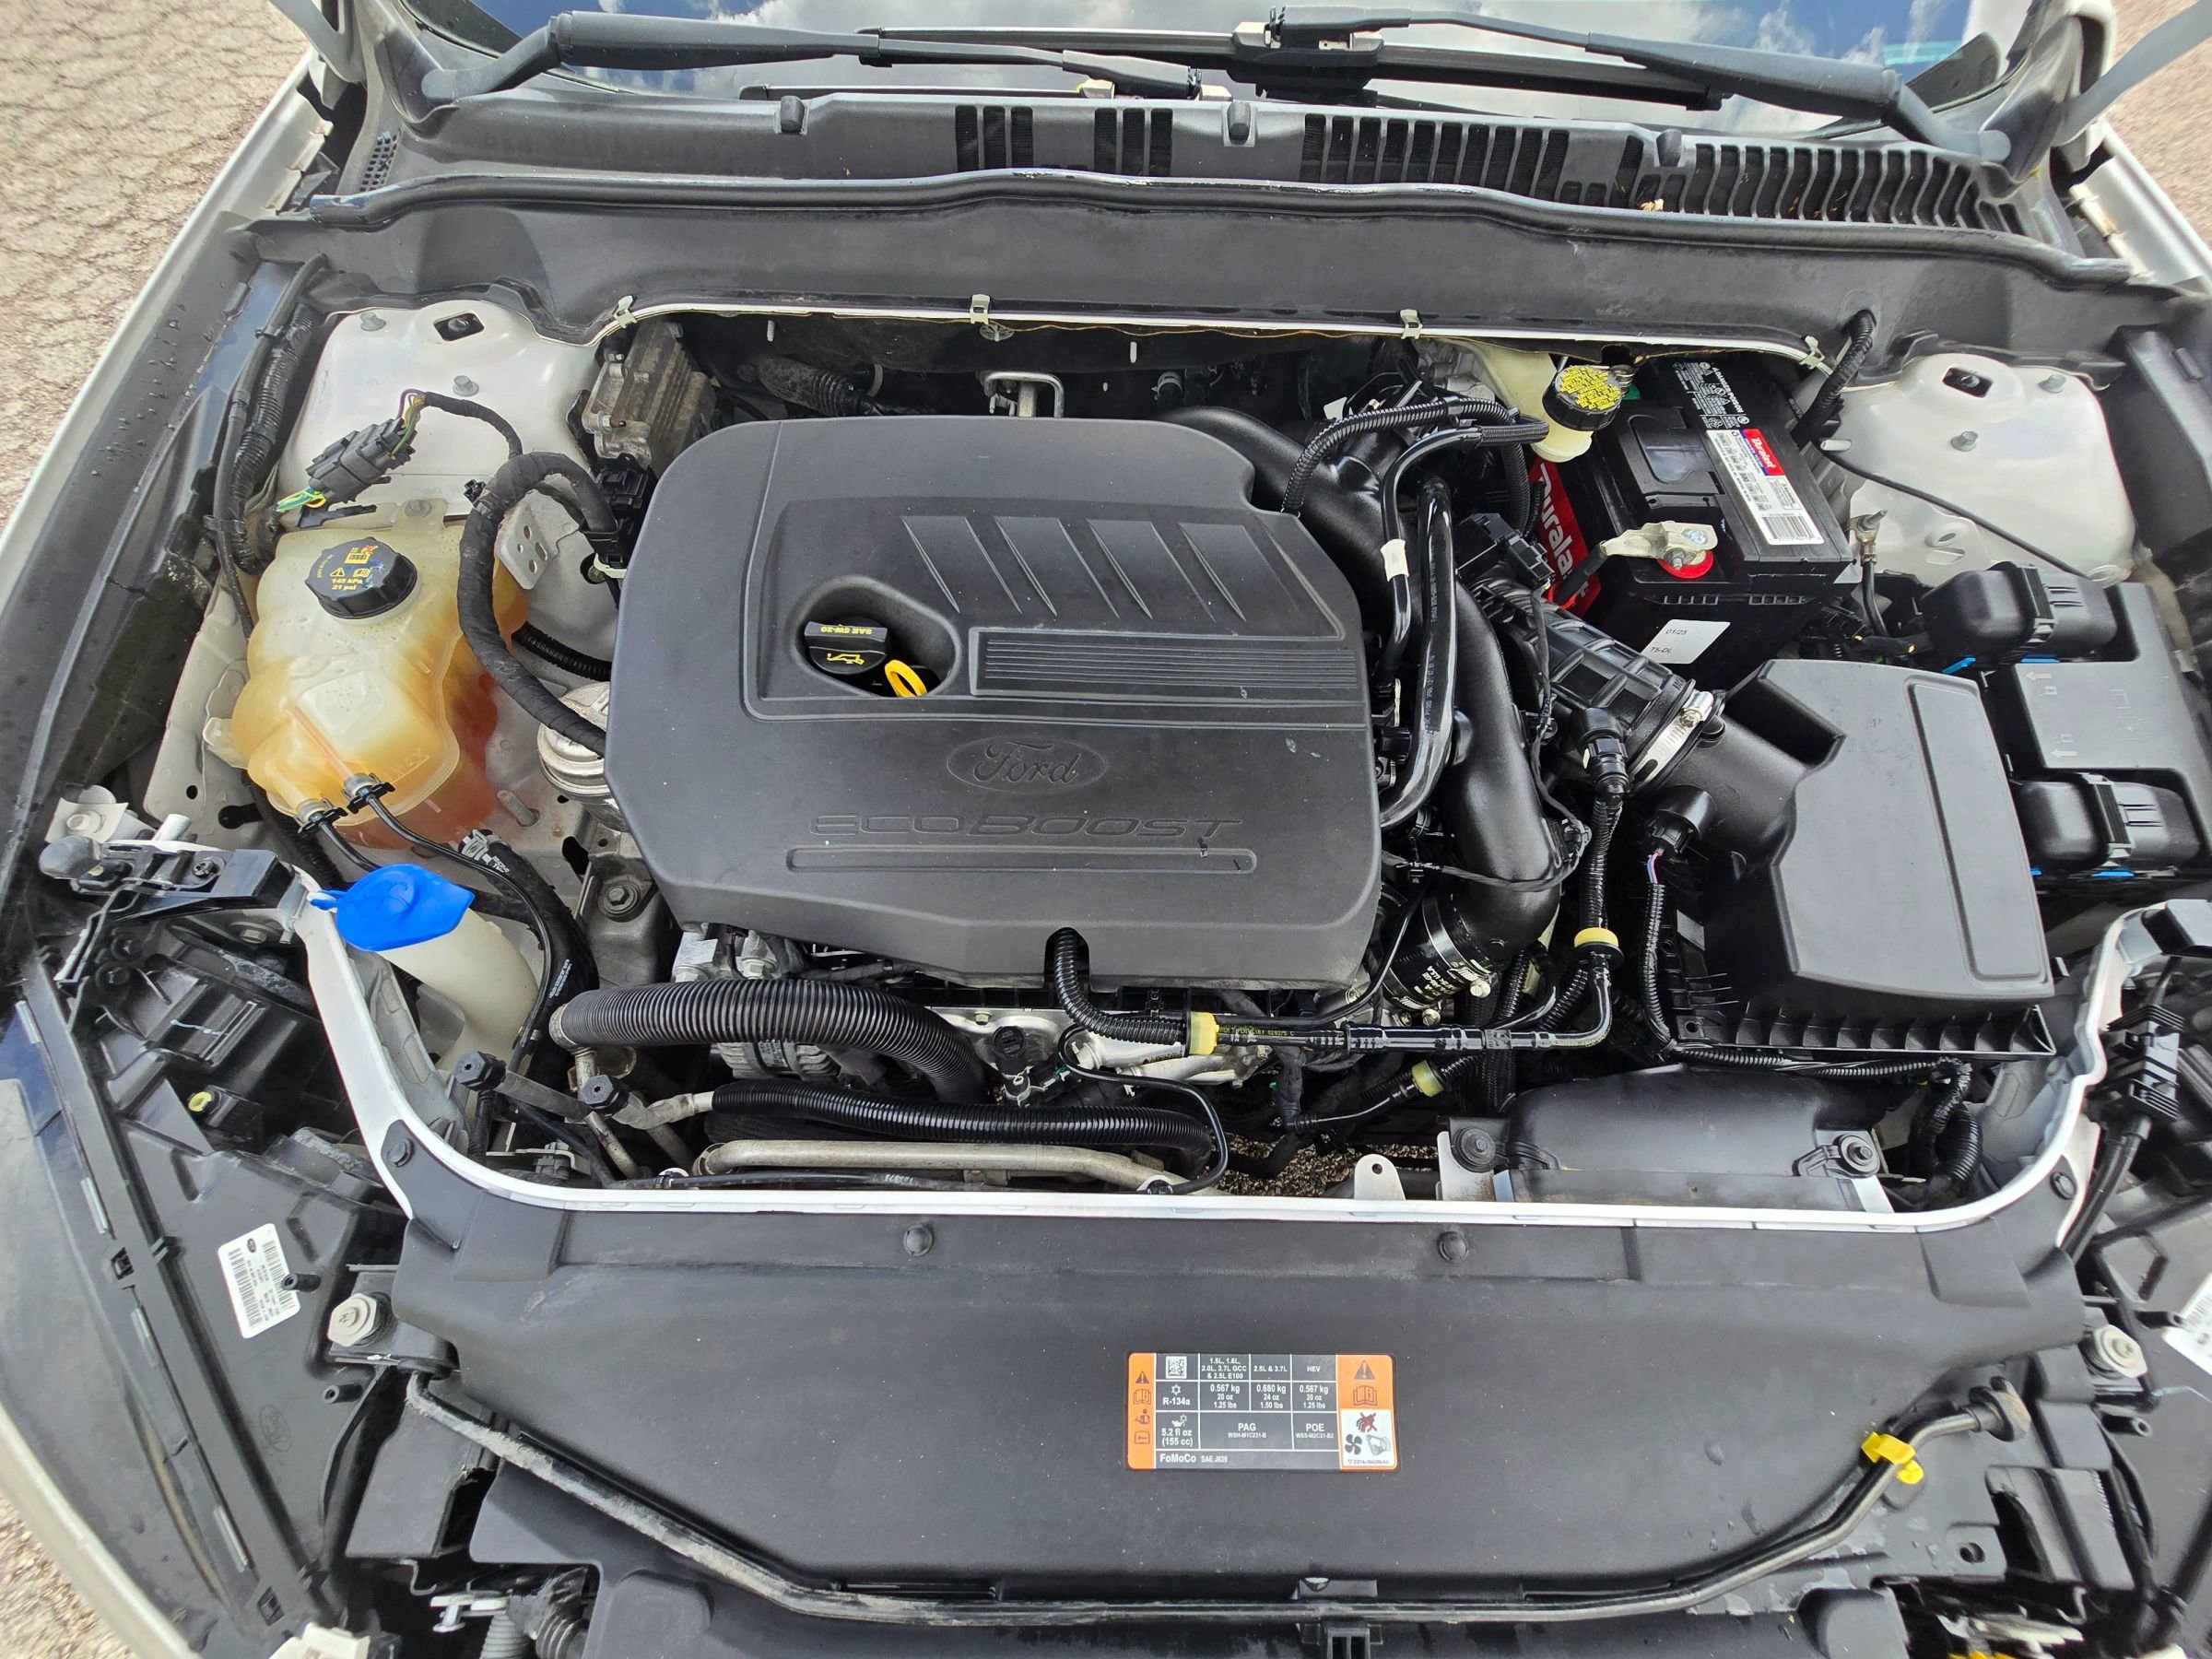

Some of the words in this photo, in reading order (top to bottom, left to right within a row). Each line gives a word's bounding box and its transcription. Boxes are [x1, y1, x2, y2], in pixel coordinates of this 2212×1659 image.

[1751, 437, 1776, 468] Duralast
[852, 627, 873, 635] SAE
[973, 740, 1082, 783] Ford
[810, 815, 1242, 837] ECOBOOST
[1209, 1383, 1230, 1393] 0.567
[1230, 1383, 1241, 1394] kg
[1256, 1383, 1276, 1393] 0.680
[1277, 1383, 1287, 1394] kg
[1299, 1384, 1318, 1394] 0.567
[1319, 1384, 1329, 1394] kg
[1162, 1396, 1191, 1406] R-134a
[1238, 1422, 1256, 1431] PAG
[1305, 1423, 1324, 1432] POE
[1161, 1428, 1173, 1437] 5.2
[1174, 1428, 1181, 1437] fl
[1182, 1429, 1193, 1437] oz
[1161, 1437, 1180, 1448] (155
[1181, 1437, 1194, 1448] cc)
[1159, 1453, 1197, 1464] FoMoCo
[1201, 1455, 1214, 1464] SAE
